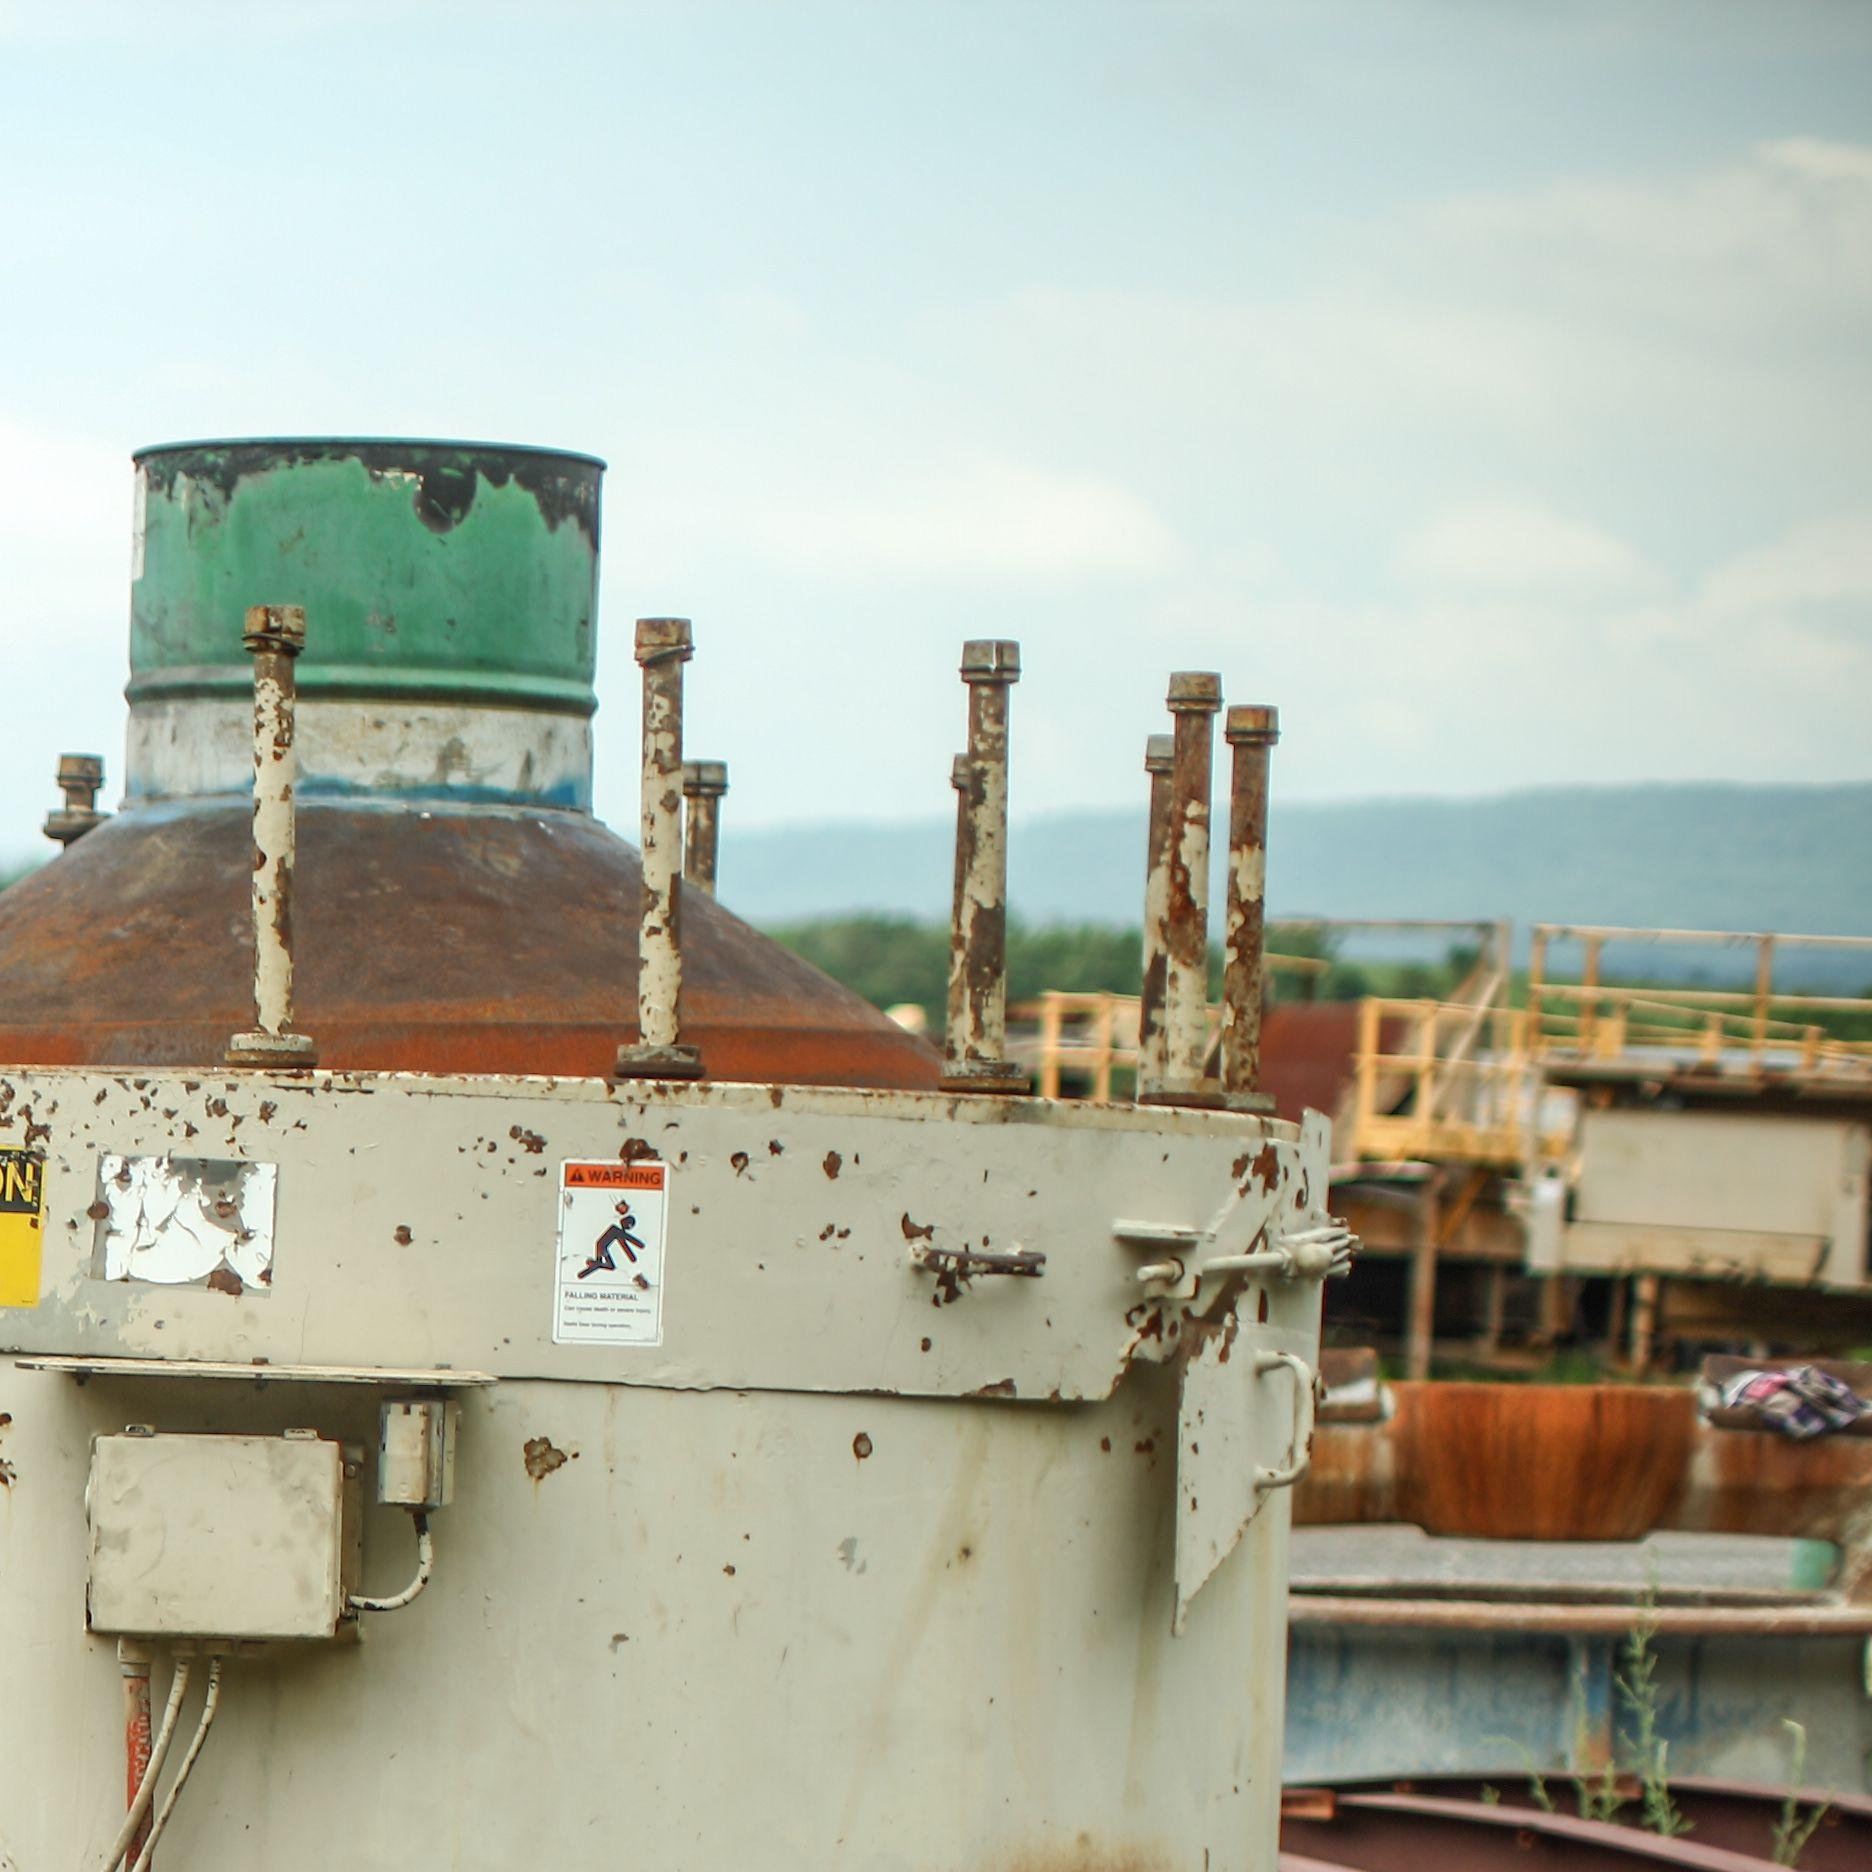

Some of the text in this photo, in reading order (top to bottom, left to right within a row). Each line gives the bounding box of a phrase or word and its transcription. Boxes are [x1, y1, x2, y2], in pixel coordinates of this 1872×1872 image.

[588, 1170, 661, 1184] WARNING
[565, 1291, 639, 1300] FALLING MATERIAL
